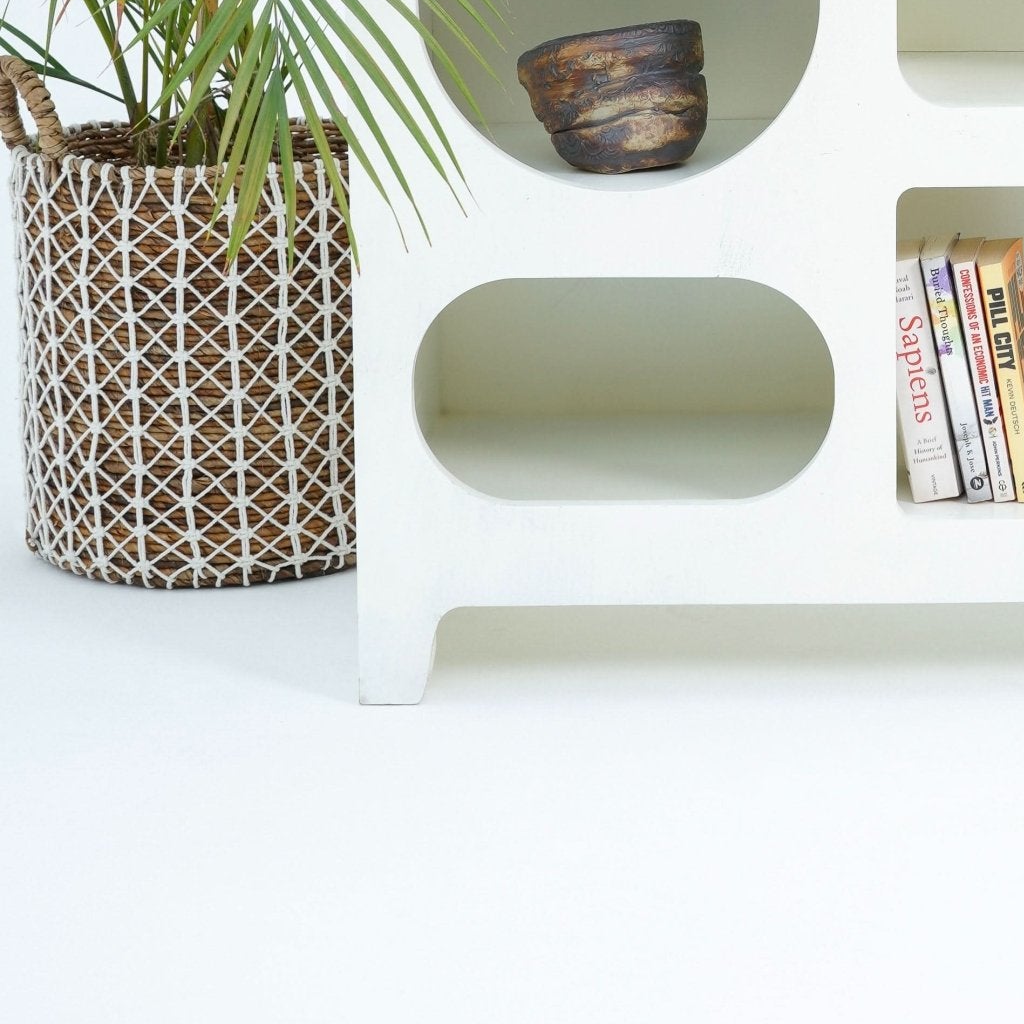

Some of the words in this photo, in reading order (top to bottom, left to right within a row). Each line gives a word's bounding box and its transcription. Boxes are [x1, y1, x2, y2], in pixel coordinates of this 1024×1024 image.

[930, 268, 945, 304] Buried
[960, 269, 977, 320] CONFESSIONS
[986, 287, 1008, 328] PILL
[969, 321, 979, 330] OF
[971, 333, 981, 344] AN
[973, 345, 989, 385] ECONOMIC
[993, 332, 1016, 370] CITY
[896, 315, 932, 424] Sapiens
[981, 386, 991, 397] HIT
[1006, 378, 1014, 400] KEVIN
[983, 399, 994, 417] MAN
[1009, 401, 1020, 435] DEUTSCH
[913, 453, 947, 464] Humankind
[914, 446, 935, 455] History
[960, 423, 970, 448] Joseph
[967, 457, 975, 473] Jose
